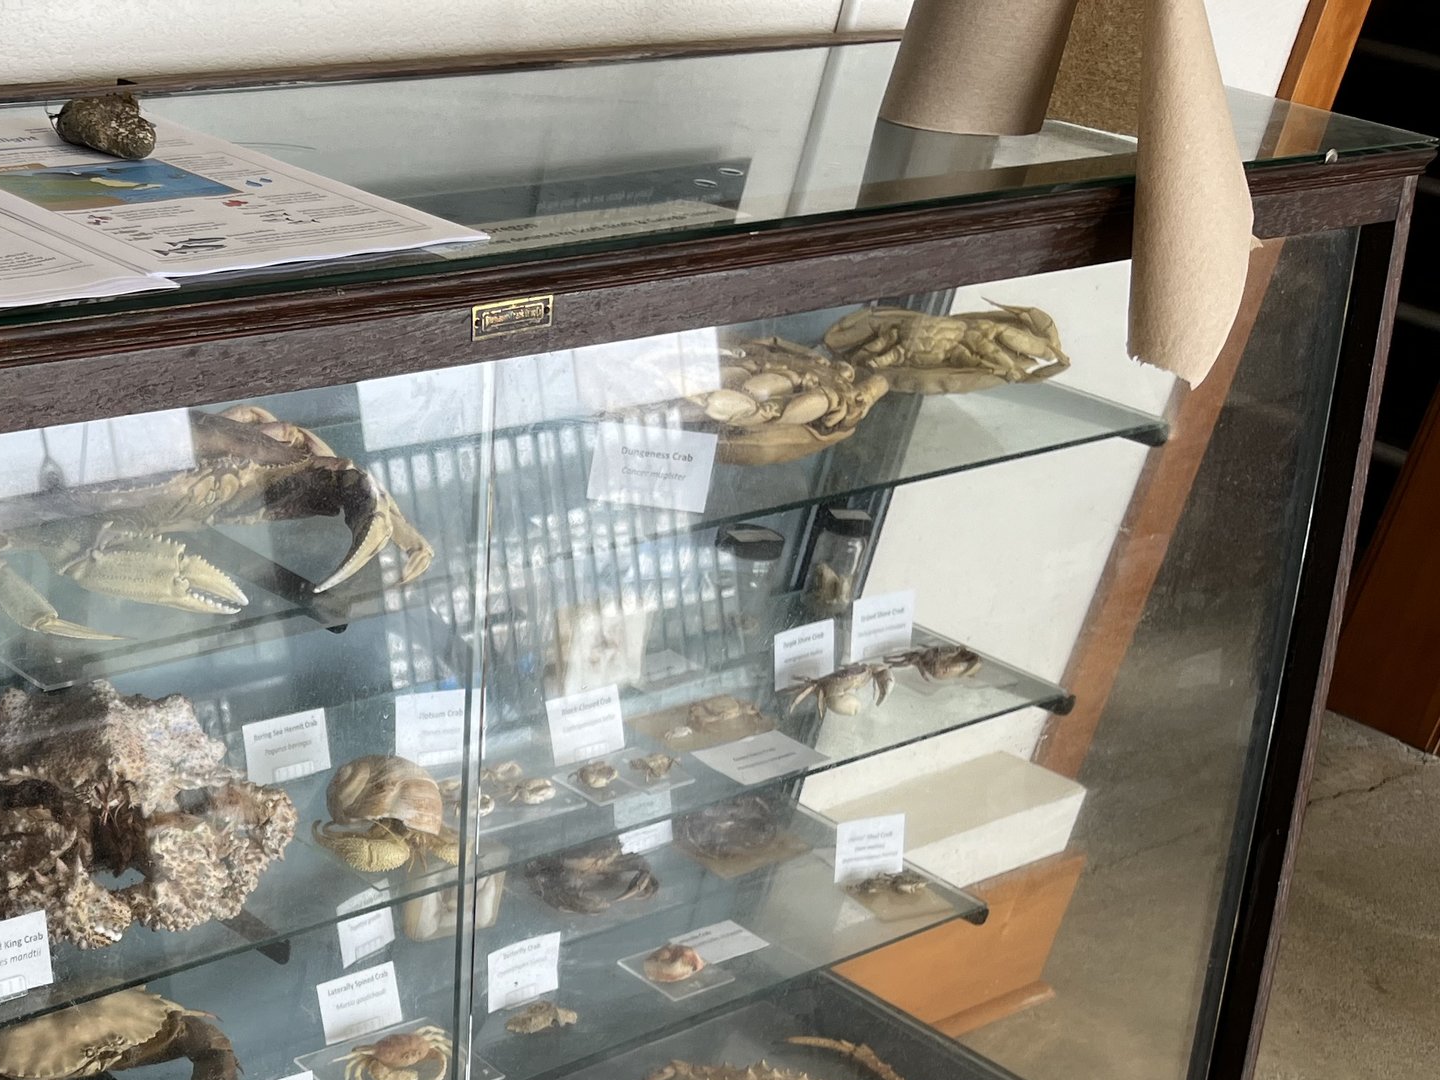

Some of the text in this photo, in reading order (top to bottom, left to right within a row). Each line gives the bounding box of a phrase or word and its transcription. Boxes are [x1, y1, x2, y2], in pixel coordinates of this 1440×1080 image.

[621, 446, 693, 462] Dungeness Crab
[447, 709, 463, 718] Crab
[304, 720, 318, 729] Crab
[4, 937, 23, 950] King
[23, 931, 44, 944] Crab
[375, 970, 389, 981] Crab
